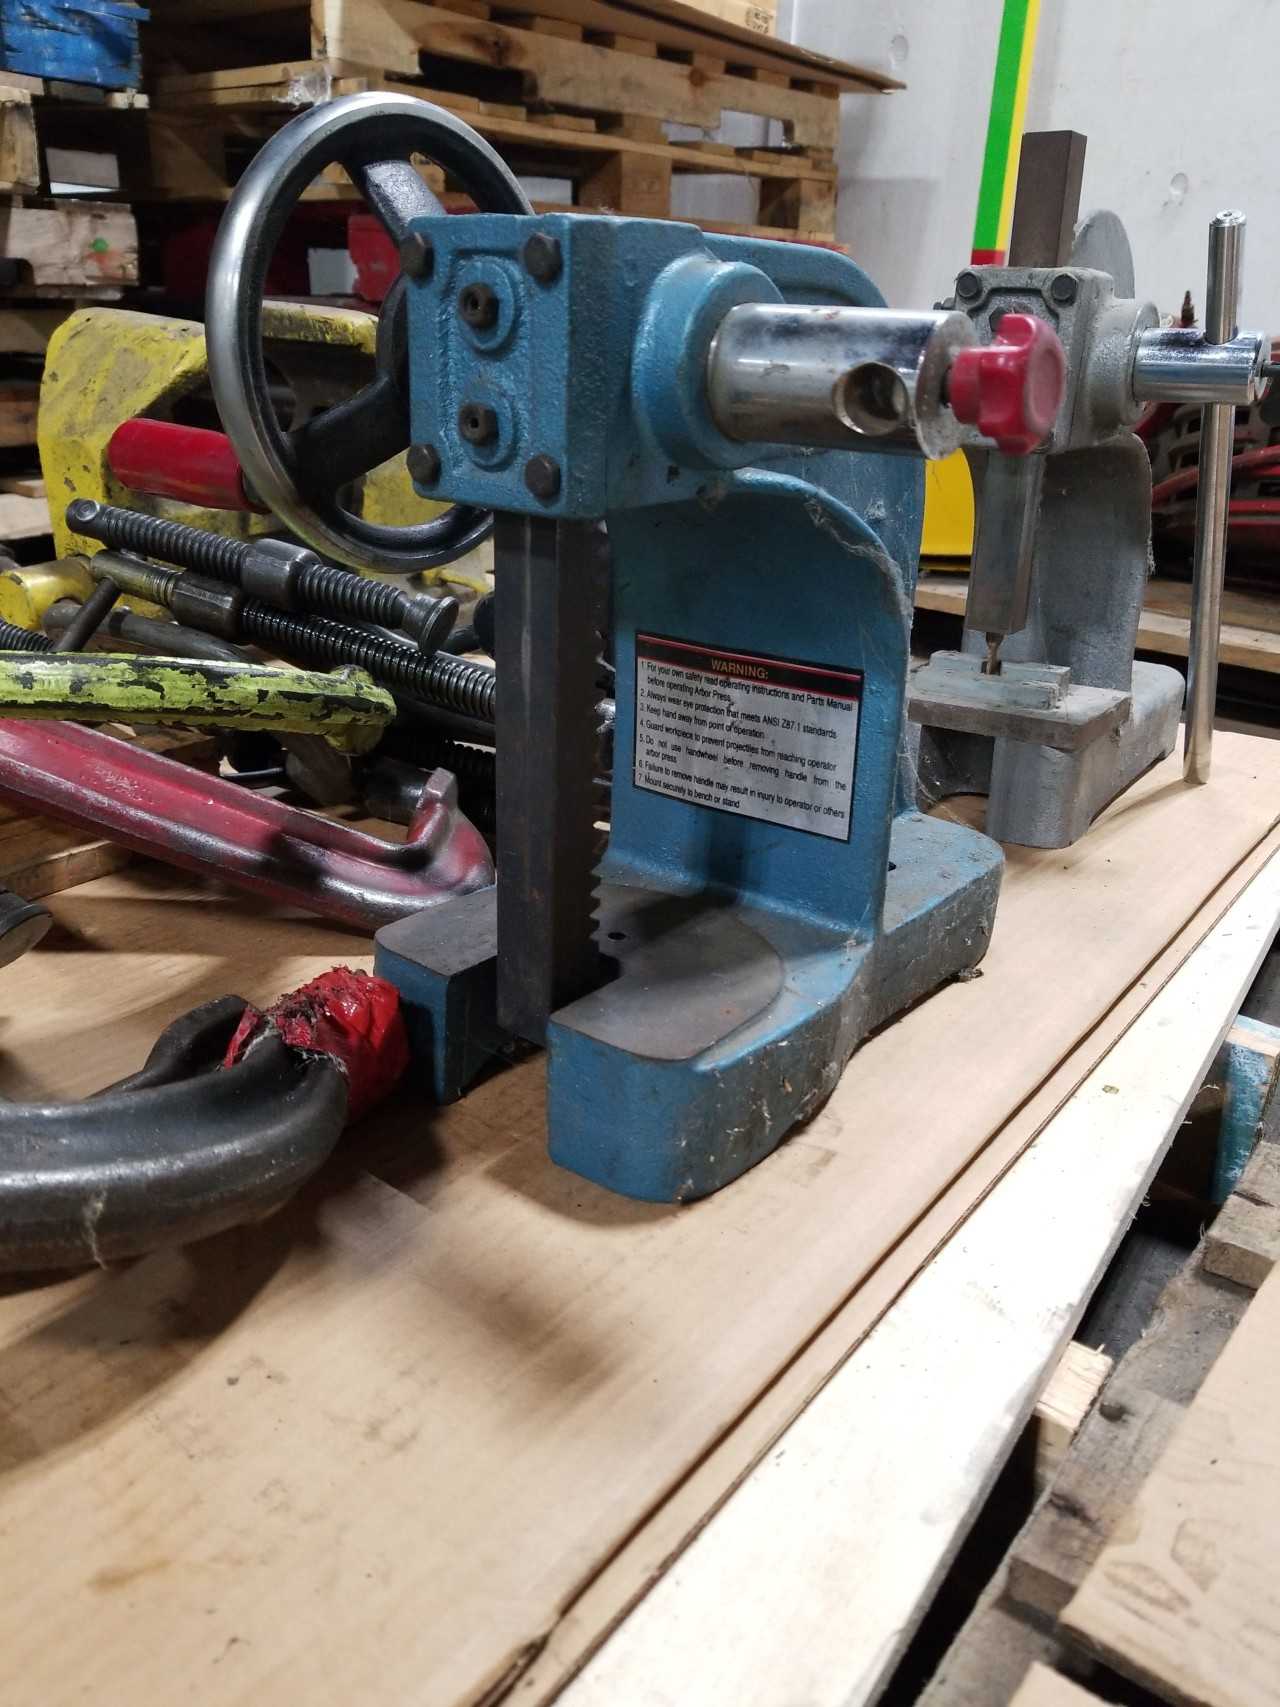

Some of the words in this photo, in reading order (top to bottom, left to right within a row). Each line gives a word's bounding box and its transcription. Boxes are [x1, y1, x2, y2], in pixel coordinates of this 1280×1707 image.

[711, 660, 768, 678] WARNING:
[646, 661, 657, 672] For
[657, 666, 671, 676] your
[671, 669, 684, 678] own
[685, 671, 703, 683] safety
[704, 676, 718, 686] read
[718, 679, 751, 693] operating
[751, 685, 790, 699] instructions
[791, 693, 805, 703] and
[806, 693, 825, 706] Parts
[826, 698, 853, 711] Manual
[647, 676, 665, 688] before
[666, 681, 694, 696] operating
[694, 686, 711, 697] Arbor
[646, 690, 667, 703] Always
[667, 696, 682, 706] wear
[683, 700, 694, 710] eye
[694, 703, 725, 715] protection
[726, 708, 739, 719] that
[740, 712, 761, 723] meets
[762, 715, 780, 727] ANSI
[646, 704, 661, 717] Keep
[662, 708, 677, 720] hand
[677, 713, 693, 725] away
[693, 715, 708, 726] from
[708, 721, 725, 730] point
[645, 719, 664, 732] Guard
[701, 736, 725, 747] prevent
[726, 741, 759, 754] projectiles
[760, 746, 776, 757] from
[776, 752, 806, 767] reaching
[646, 748, 661, 758] arbor
[658, 740, 668, 748] not
[671, 744, 682, 753] use
[685, 746, 718, 761] handwheel
[723, 755, 744, 768] before
[749, 763, 780, 777] removing
[784, 769, 808, 782] handle
[813, 774, 829, 786] from
[834, 780, 847, 791] the
[644, 760, 664, 774] Failure
[671, 770, 693, 782] remove
[693, 775, 714, 787] handle
[715, 781, 729, 791] may
[730, 785, 749, 795] result
[757, 791, 776, 804] injury
[784, 797, 812, 811] operator
[644, 774, 662, 787] Mount
[662, 782, 686, 795] securely
[693, 789, 713, 801] bench
